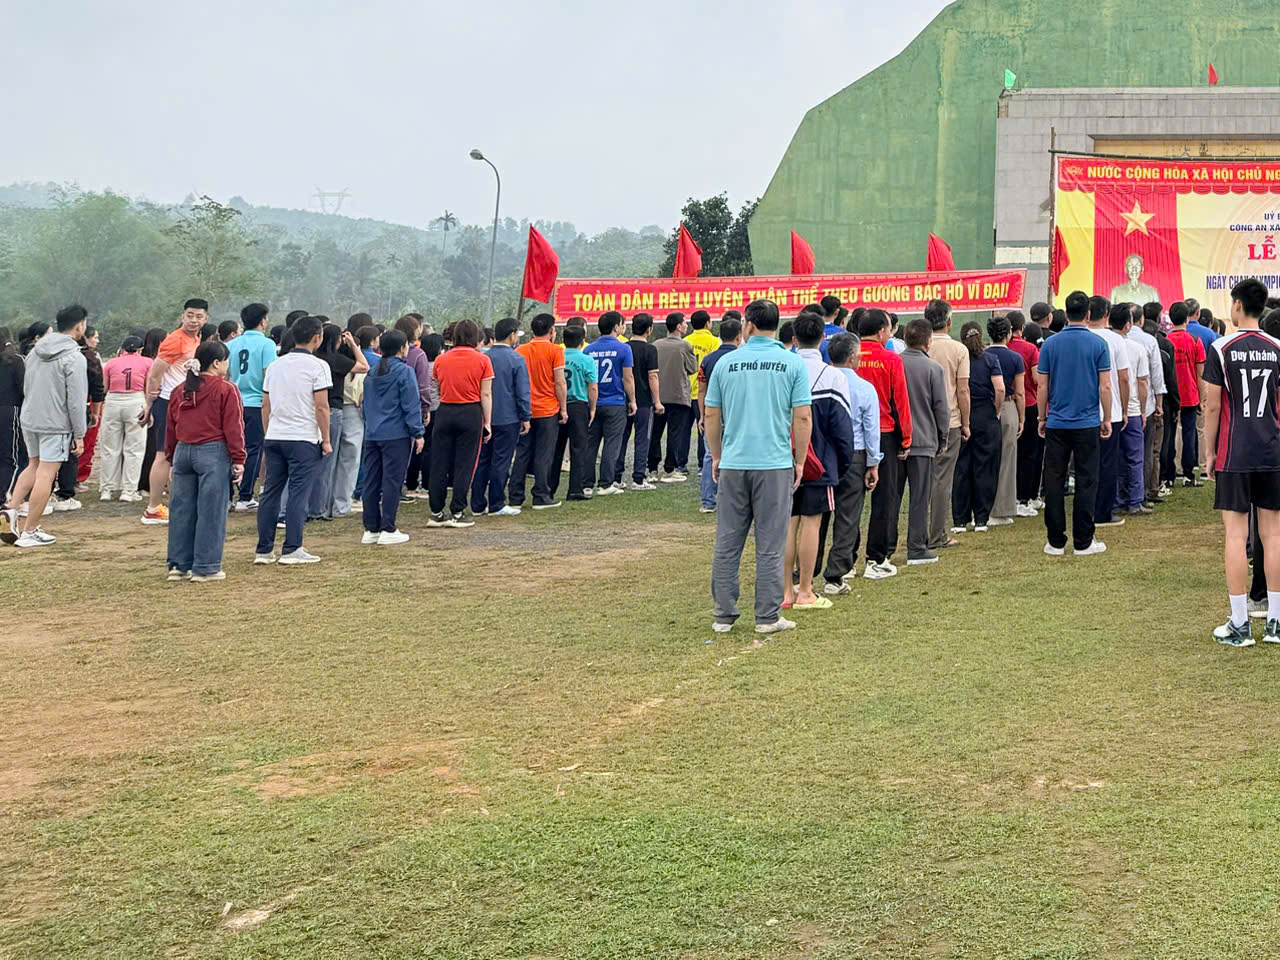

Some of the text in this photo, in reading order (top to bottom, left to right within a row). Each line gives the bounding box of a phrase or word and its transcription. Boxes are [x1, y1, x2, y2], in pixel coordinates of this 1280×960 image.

[1087, 165, 1122, 179] NƯỚC
[1125, 166, 1161, 181] CỘNG
[1163, 166, 1189, 180] HÒA
[1192, 167, 1209, 180] XÃ
[1212, 167, 1234, 182] HỘI
[1237, 166, 1262, 180] CHỦ
[1229, 223, 1253, 232] CÔNG
[1255, 224, 1267, 232] AN
[1247, 234, 1277, 260] LỄ
[1206, 272, 1227, 290] NGÀY
[1229, 275, 1248, 290] CH
[573, 289, 616, 312] TOÀN
[620, 289, 654, 311] DÂN
[658, 288, 691, 310] RÈN
[695, 287, 743, 312] LUYỆN
[792, 282, 820, 305] THỂ
[863, 284, 910, 303] GƯƠNG
[914, 281, 942, 301] BÁC
[967, 280, 981, 300] VĨ
[1230, 349, 1278, 363] Duy Khánh
[728, 362, 738, 373] AE
[760, 360, 787, 373] HUYỆN
[121, 367, 132, 391] 1
[1239, 368, 1273, 418] 17
